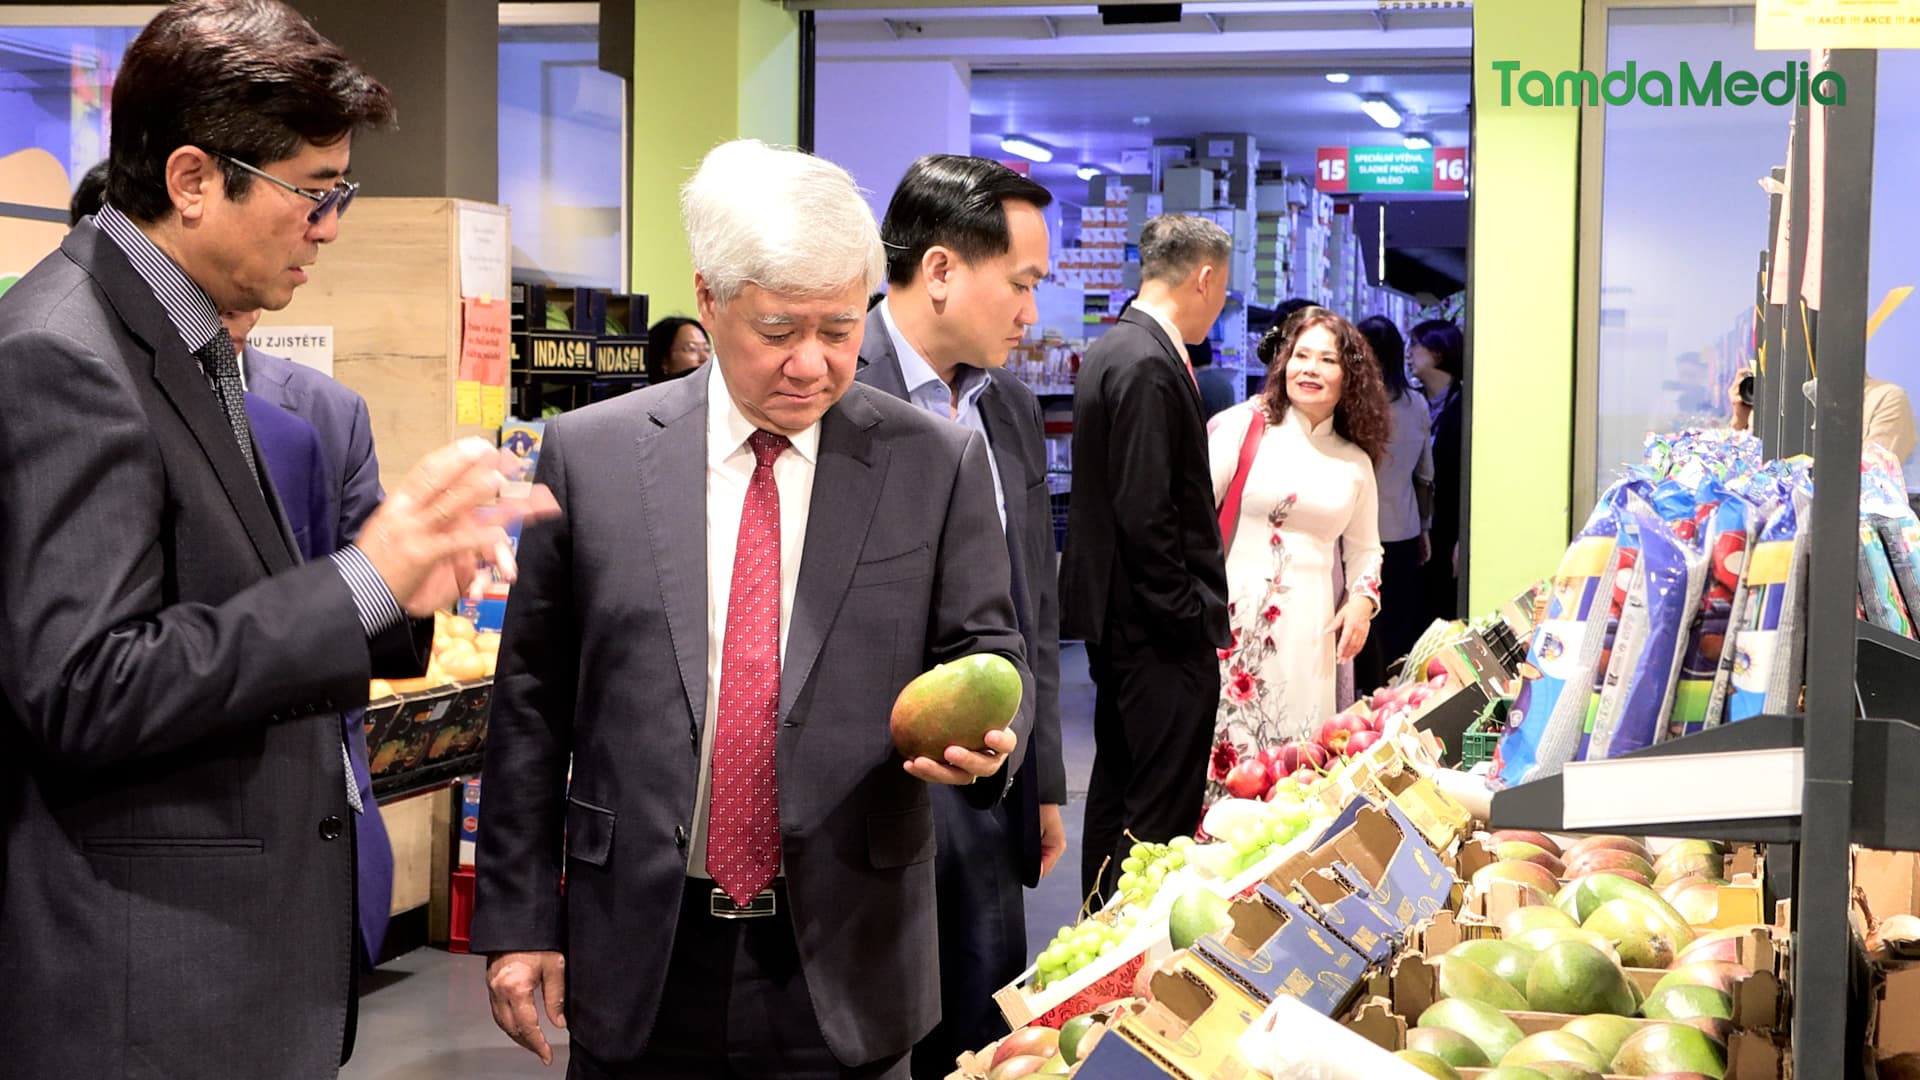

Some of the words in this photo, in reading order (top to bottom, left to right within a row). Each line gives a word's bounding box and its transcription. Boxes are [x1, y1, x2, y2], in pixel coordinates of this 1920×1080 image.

[1818, 16, 1846, 24] AKCE
[1863, 16, 1892, 24] AKCE
[1318, 159, 1346, 181] 15
[1359, 164, 1388, 174] SLADKÉ
[1435, 159, 1464, 181] 16
[1376, 175, 1405, 185] MLÉKO
[266, 333, 326, 348] ZJISTĚTE
[533, 339, 593, 368] INDASOL
[597, 346, 646, 373] NDASOL
